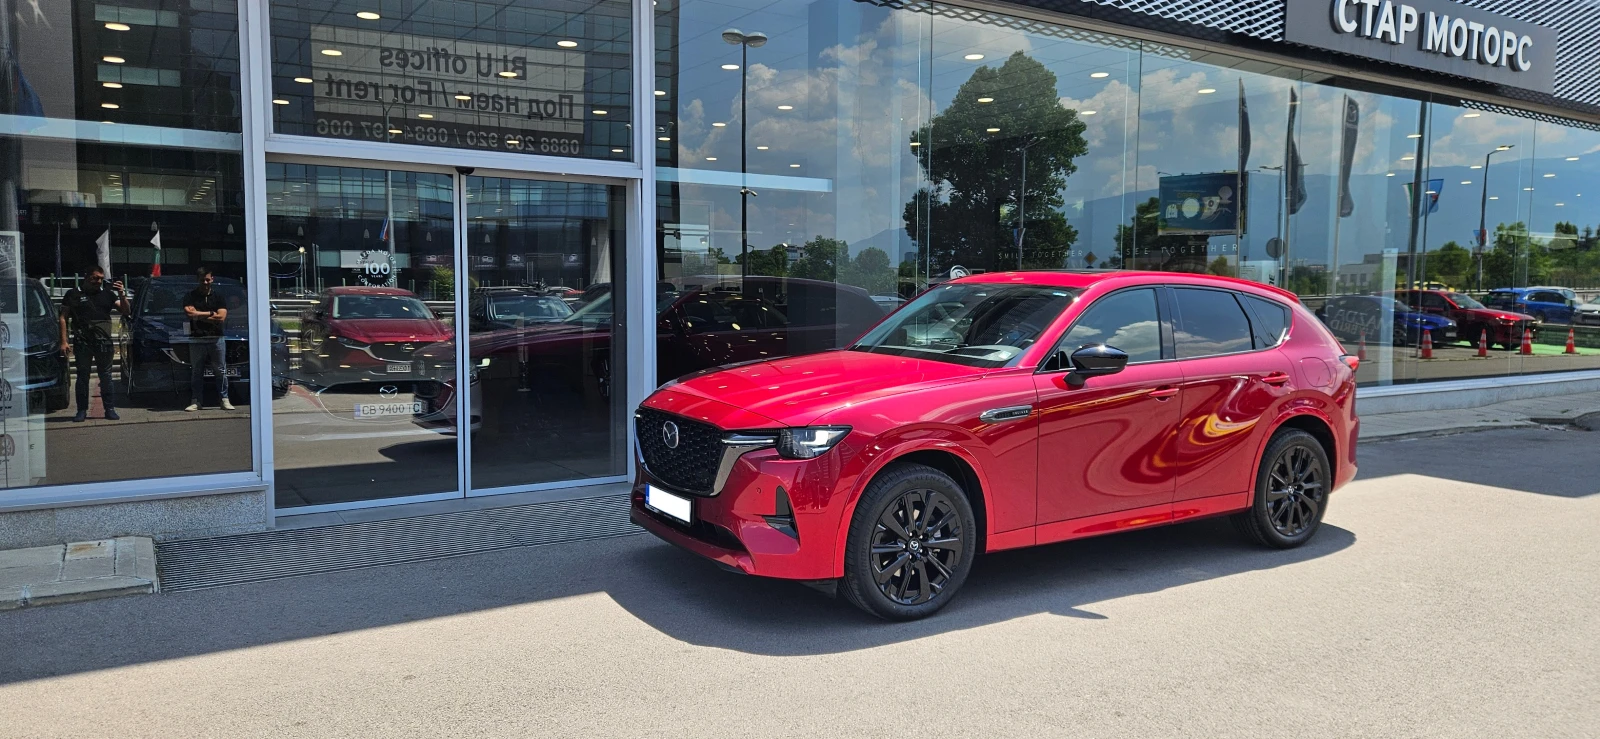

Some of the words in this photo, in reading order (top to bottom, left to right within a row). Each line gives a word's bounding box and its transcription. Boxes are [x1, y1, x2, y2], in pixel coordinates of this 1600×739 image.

[1333, 0, 1418, 44] СТАР
[1422, 11, 1532, 72] МОТОРС
[998, 252, 1025, 260] SMILE
[1032, 250, 1083, 258] TOGETHER
[1126, 247, 1149, 256] SEE
[1161, 244, 1238, 254] TOGETHER
[363, 262, 390, 275] 100
[362, 405, 377, 415] CB
[378, 404, 405, 414] 9400
